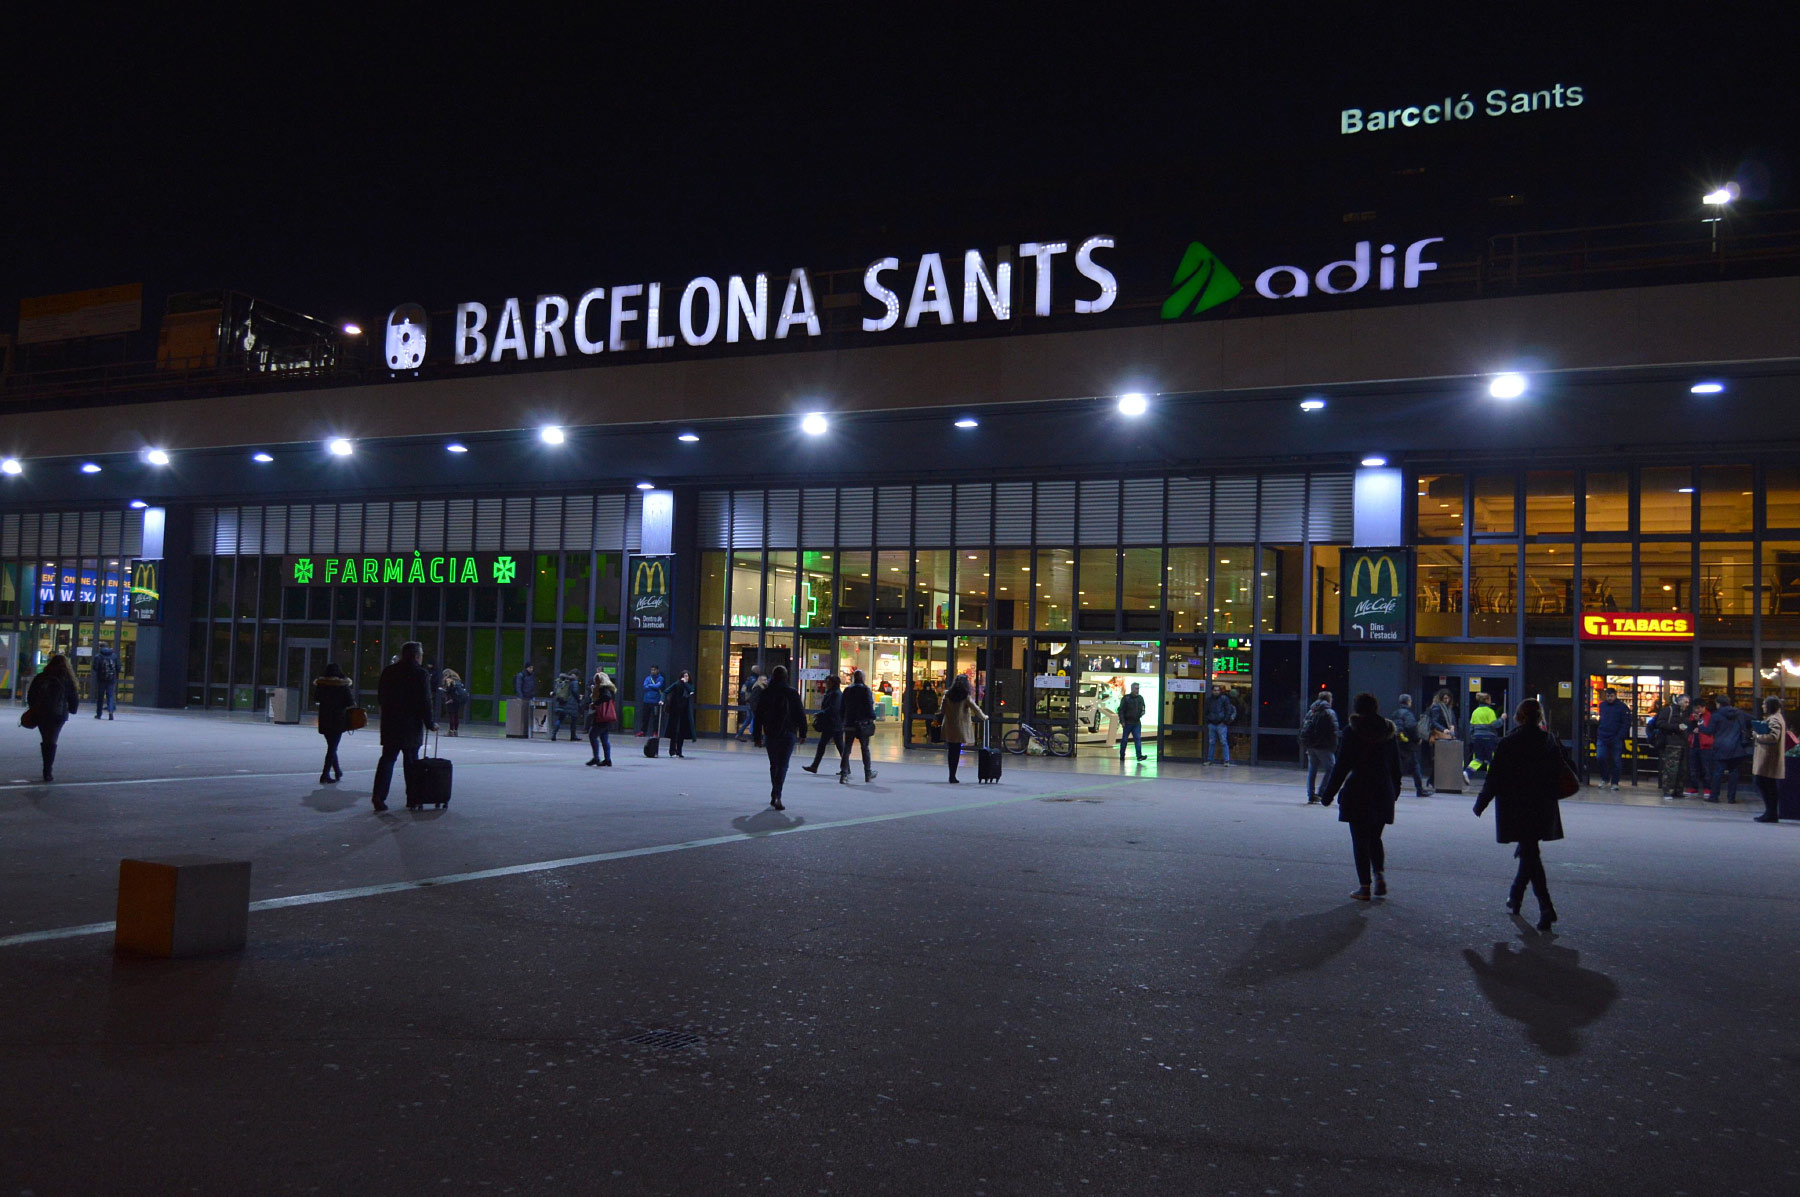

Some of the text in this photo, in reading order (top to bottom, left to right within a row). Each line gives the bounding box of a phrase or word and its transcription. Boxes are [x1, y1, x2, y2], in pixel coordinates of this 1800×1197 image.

[1485, 83, 1584, 117] Sants
[1254, 237, 1444, 299] adif
[454, 236, 1118, 366] BARCELONA SANTS
[325, 549, 479, 584] FARMÀCIA
[1370, 622, 1385, 631] Dins
[1612, 618, 1688, 632] TABACS
